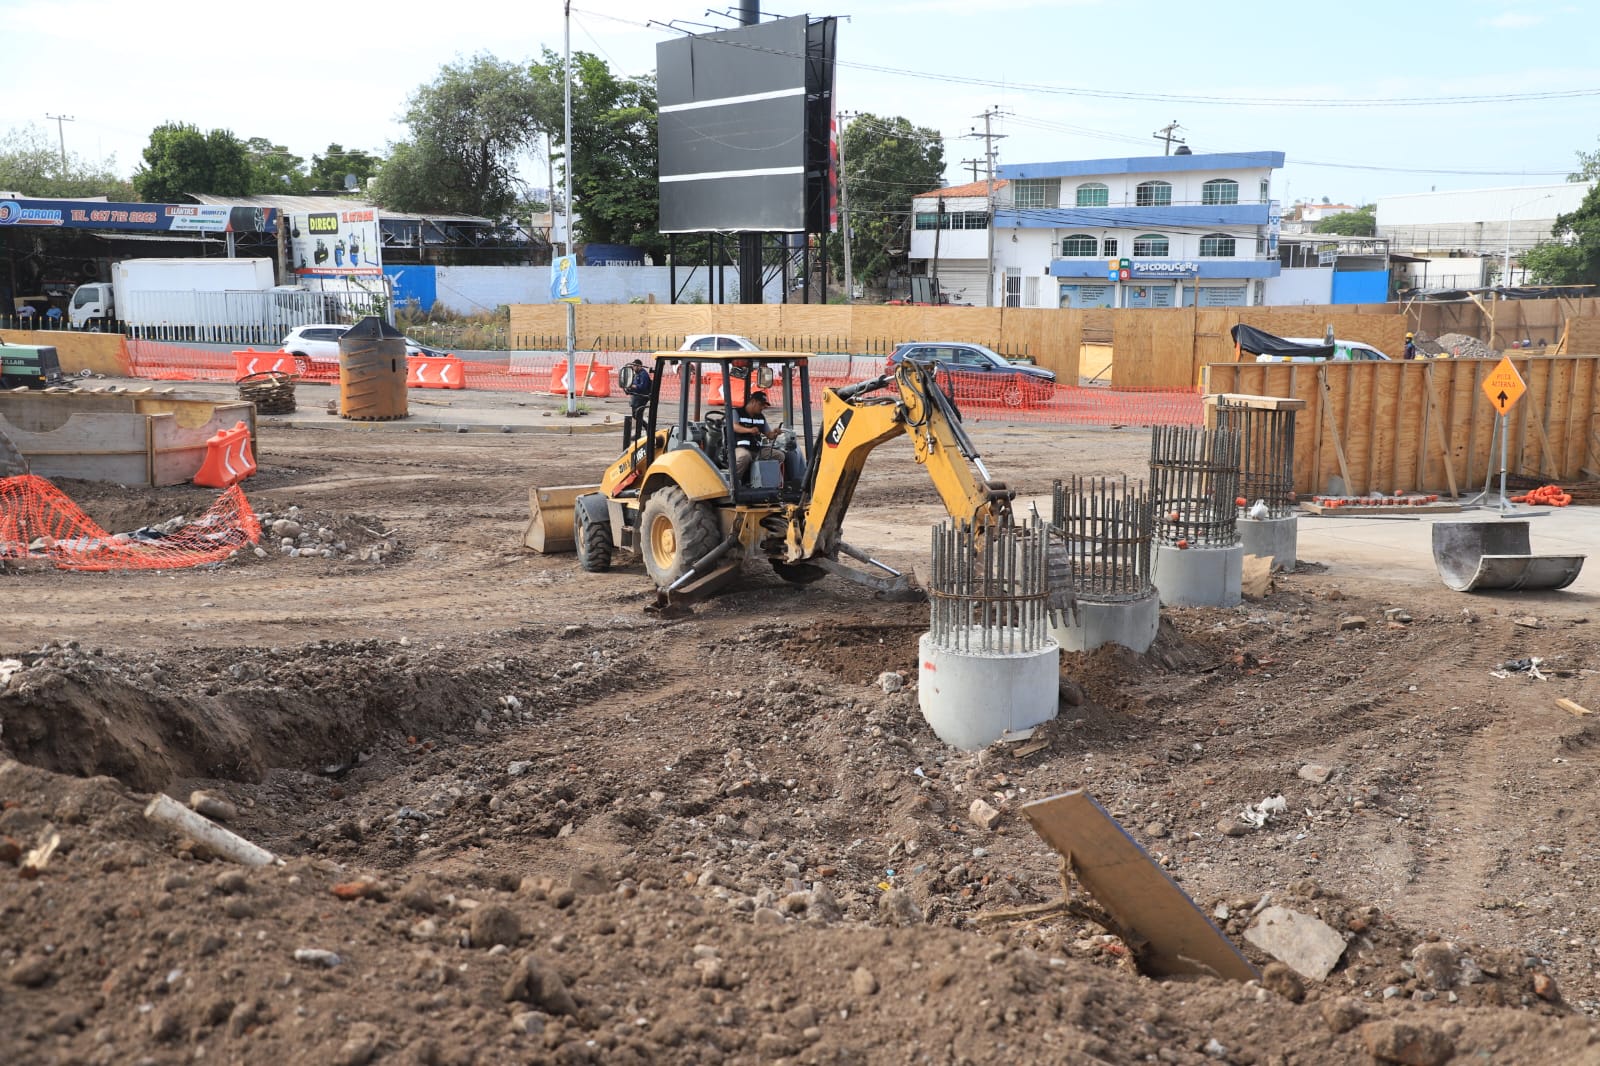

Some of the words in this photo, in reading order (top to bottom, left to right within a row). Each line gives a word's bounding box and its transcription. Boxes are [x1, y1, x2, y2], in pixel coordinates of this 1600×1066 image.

[21, 209, 61, 220] CORONA
[170, 207, 194, 215] LLANTAS
[309, 217, 337, 230] DIRECO
[1133, 261, 1199, 272] PSICODUCERE
[832, 417, 845, 443] CAT
